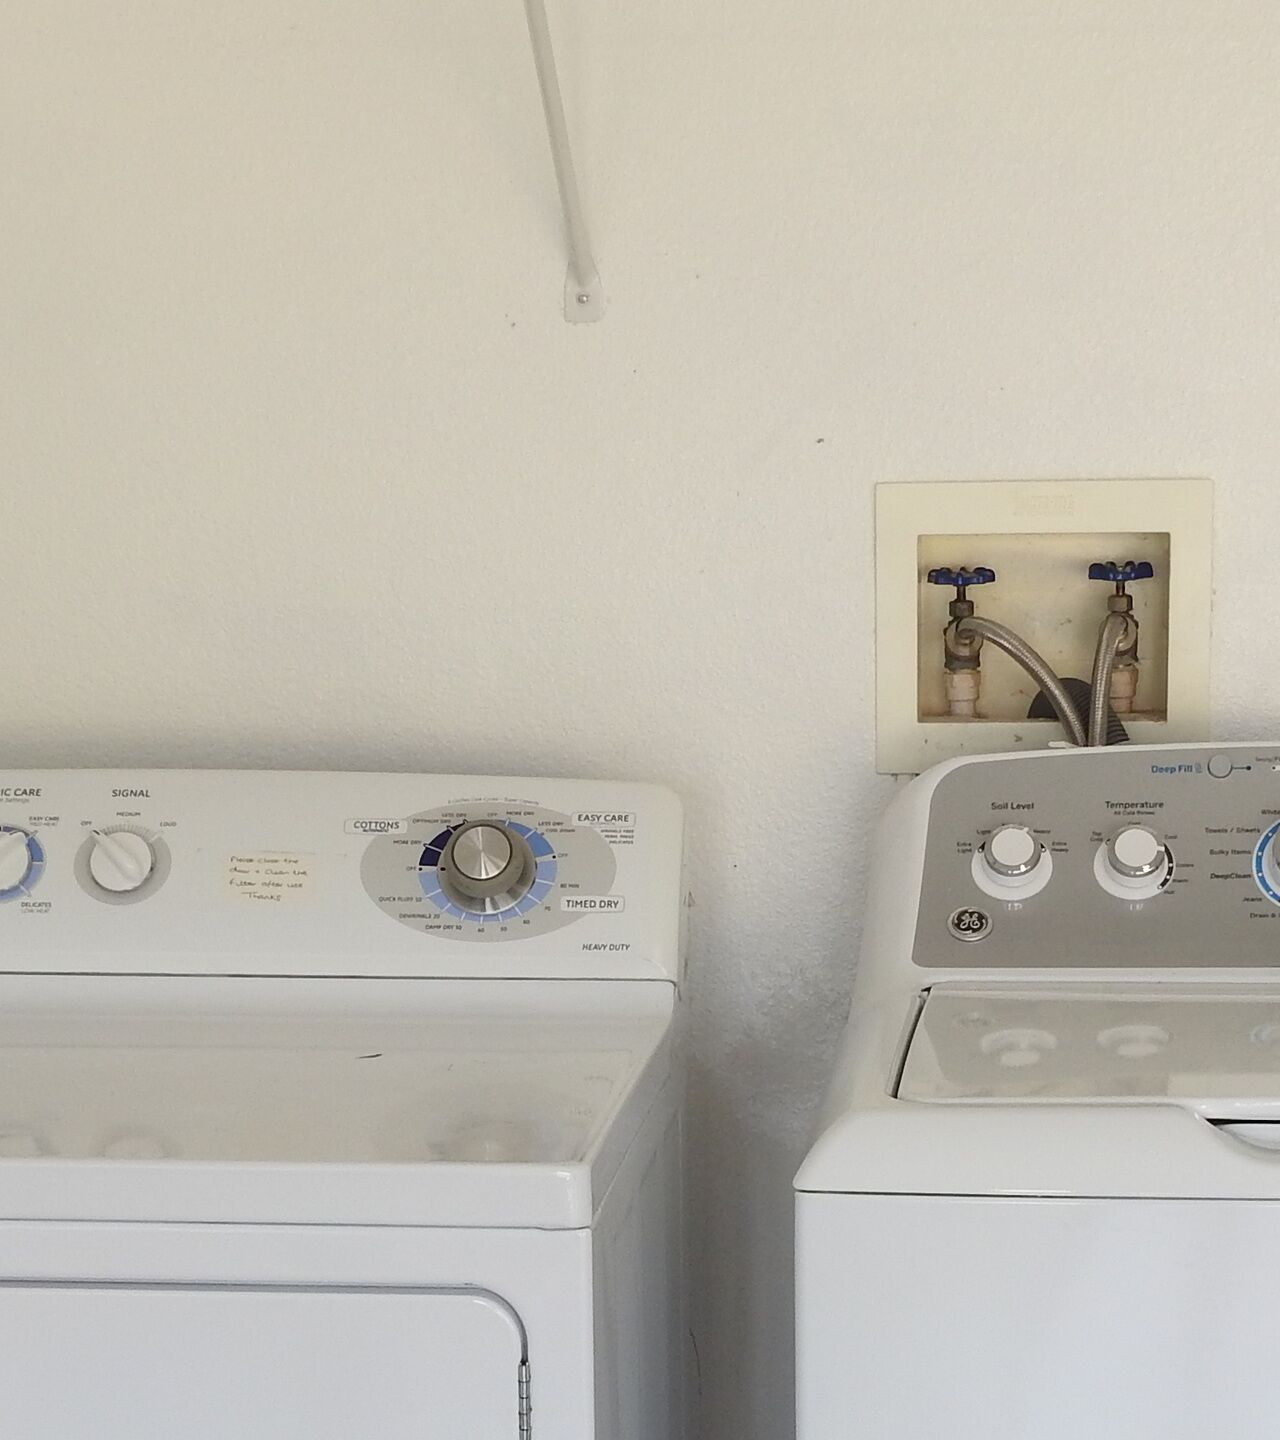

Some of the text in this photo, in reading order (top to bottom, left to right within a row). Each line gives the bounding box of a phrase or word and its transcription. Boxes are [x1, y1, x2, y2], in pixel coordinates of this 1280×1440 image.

[1151, 764, 1193, 774] Deep Fill
[13, 788, 41, 797] CARE
[111, 789, 151, 798] SIGNAL
[991, 801, 1035, 810] Soil Level
[1105, 800, 1164, 810] Temperature
[578, 814, 630, 822] EASY CARE
[353, 820, 400, 830] COTTONS
[1210, 872, 1252, 880] DeepClean
[565, 899, 620, 909] TIMED DRY
[582, 943, 631, 951] HEAVY DUTY
